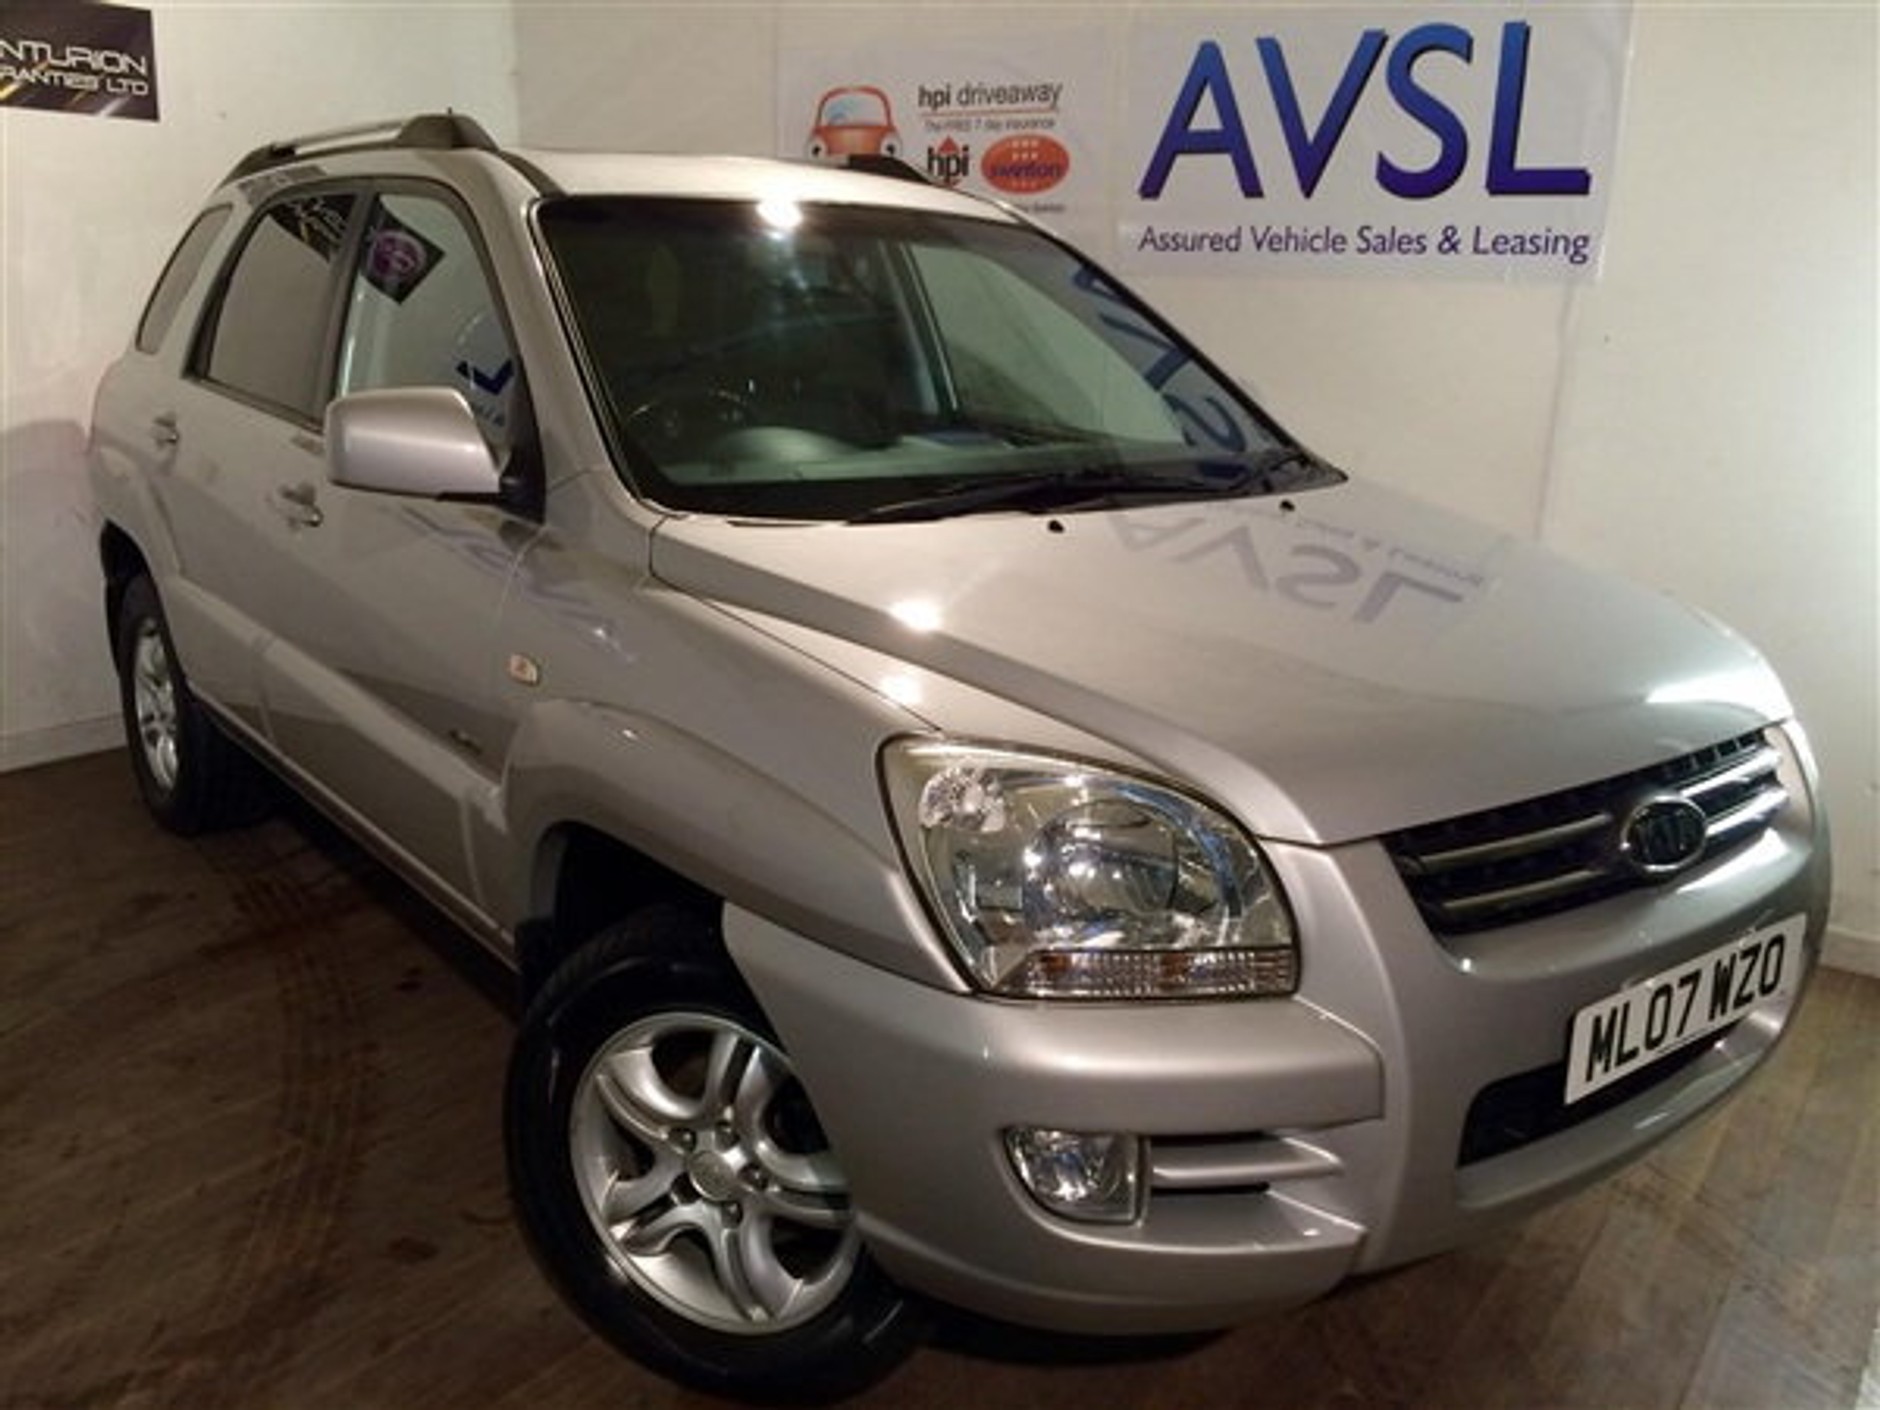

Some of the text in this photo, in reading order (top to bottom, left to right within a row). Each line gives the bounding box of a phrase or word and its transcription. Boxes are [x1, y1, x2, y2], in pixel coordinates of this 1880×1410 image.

[106, 77, 148, 96] LTD
[918, 82, 1062, 111] hpi driveaway
[1138, 21, 1592, 199] AVSL
[927, 145, 970, 183] hpi
[1138, 225, 1591, 264] Assured Vehicle Sales & Leasing
[1585, 933, 1786, 1083] ML07 WZO
